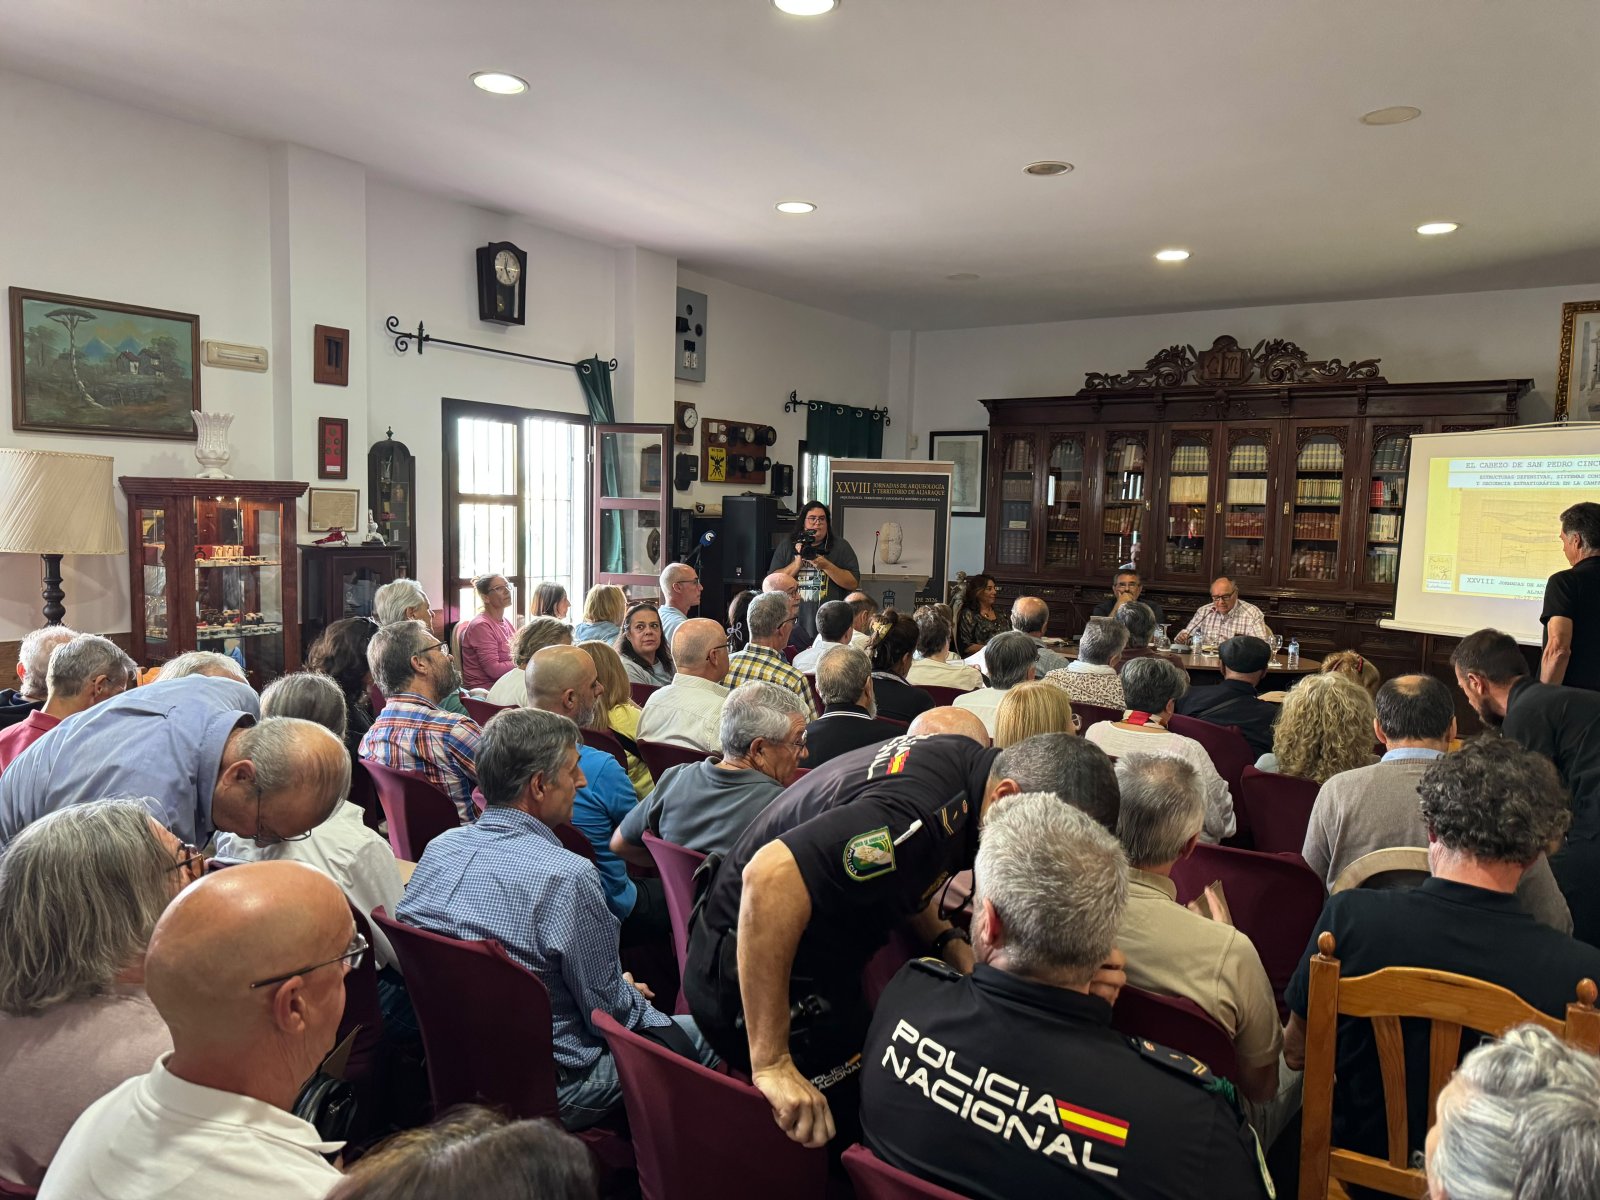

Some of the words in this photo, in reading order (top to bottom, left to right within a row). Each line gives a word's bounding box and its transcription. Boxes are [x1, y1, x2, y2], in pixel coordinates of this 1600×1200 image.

[1480, 461, 1509, 469] CABEZO
[1547, 460, 1573, 468] PEDRO
[835, 481, 871, 494] XXVIII
[1467, 577, 1495, 585] XXVIII
[881, 1045, 1119, 1177] NACIONAL
